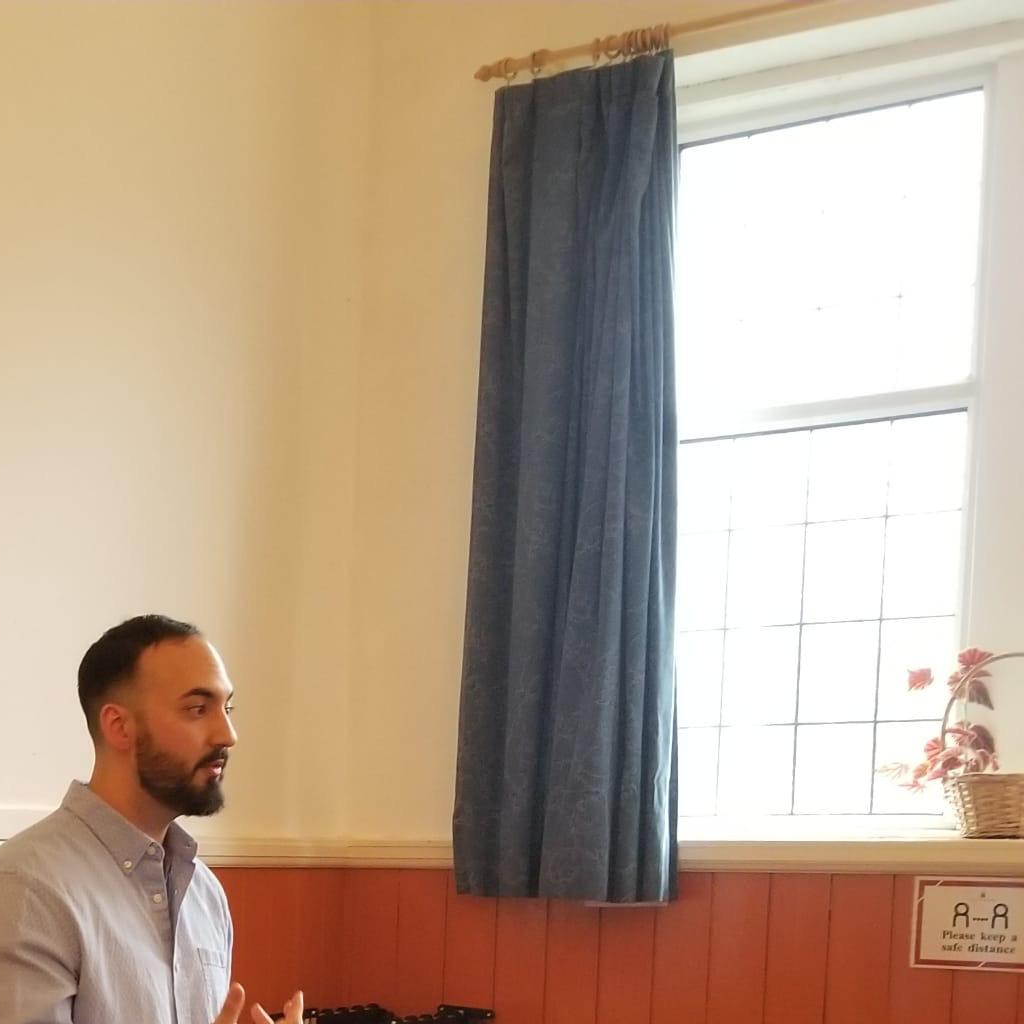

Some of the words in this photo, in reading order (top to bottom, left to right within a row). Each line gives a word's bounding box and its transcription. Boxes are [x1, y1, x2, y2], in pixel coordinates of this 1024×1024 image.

[942, 930, 976, 940] Please
[980, 932, 1007, 943] keep
[941, 943, 963, 952] safe
[967, 944, 1016, 954] distance
